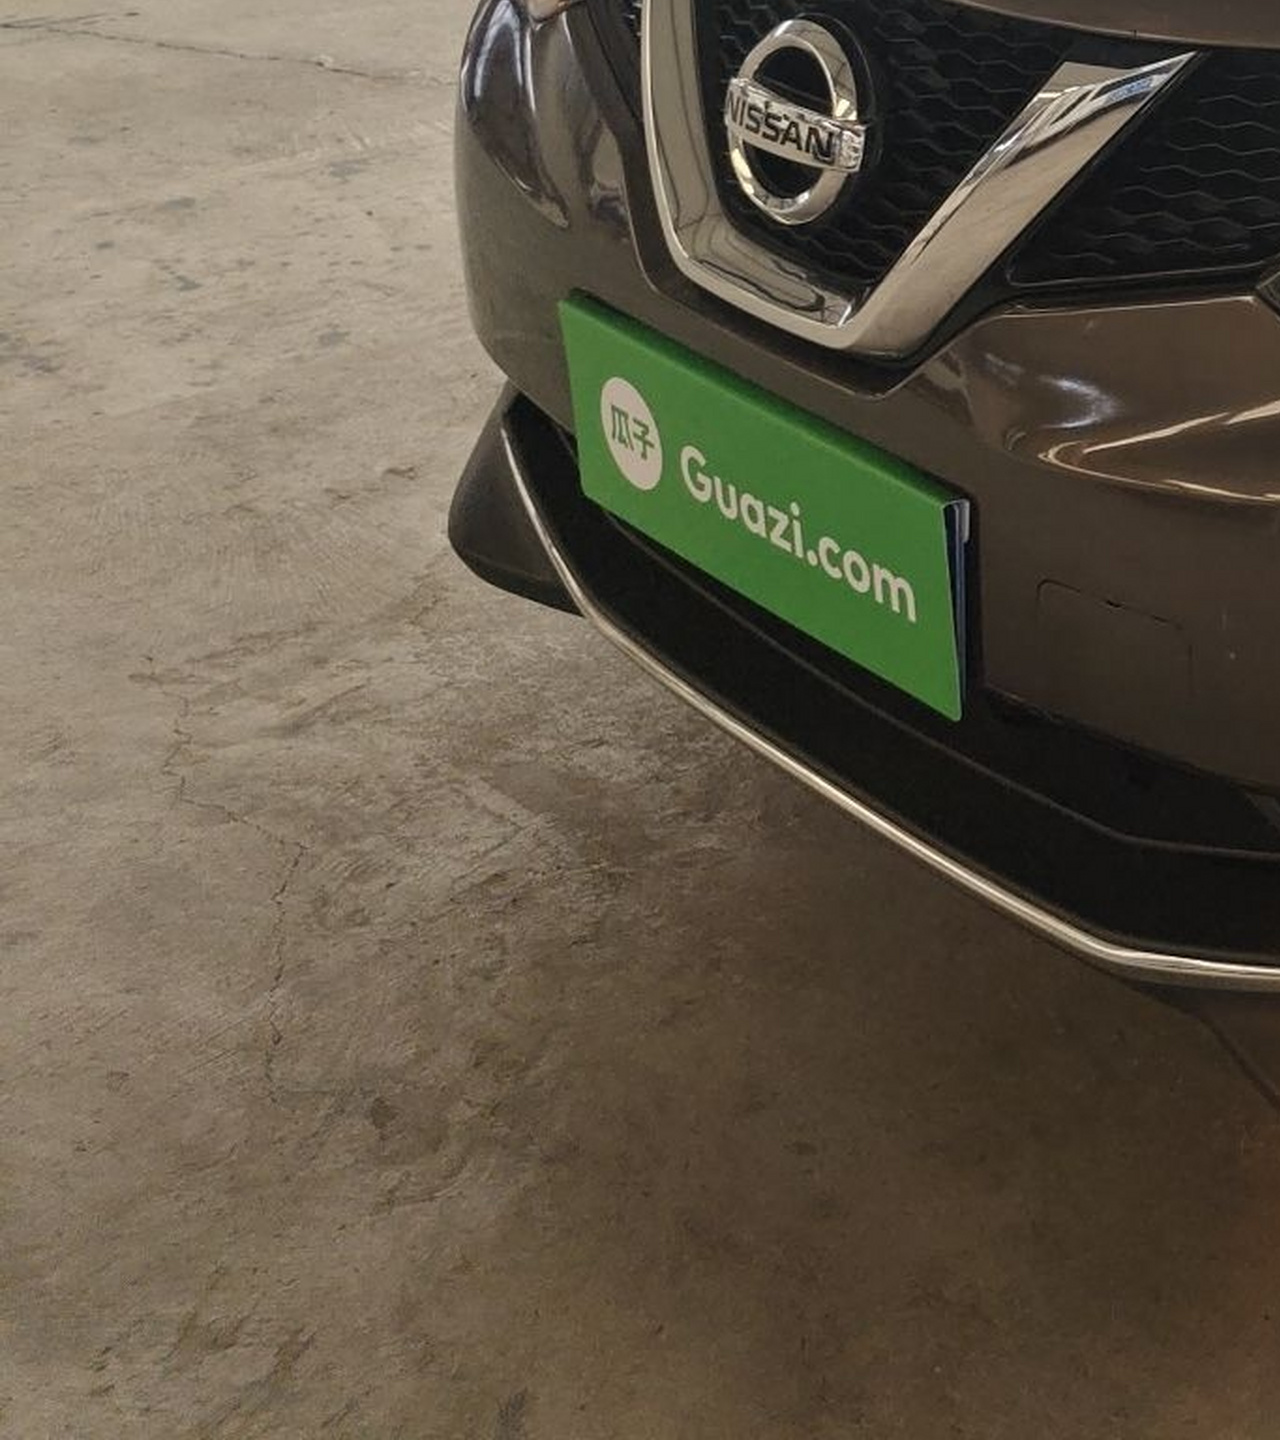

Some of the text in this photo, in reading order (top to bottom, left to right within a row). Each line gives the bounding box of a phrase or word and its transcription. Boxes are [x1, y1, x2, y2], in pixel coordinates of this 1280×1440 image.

[727, 89, 835, 163] NISSAN
[610, 404, 656, 461] 瓜子
[680, 445, 917, 624] Guazi.com
